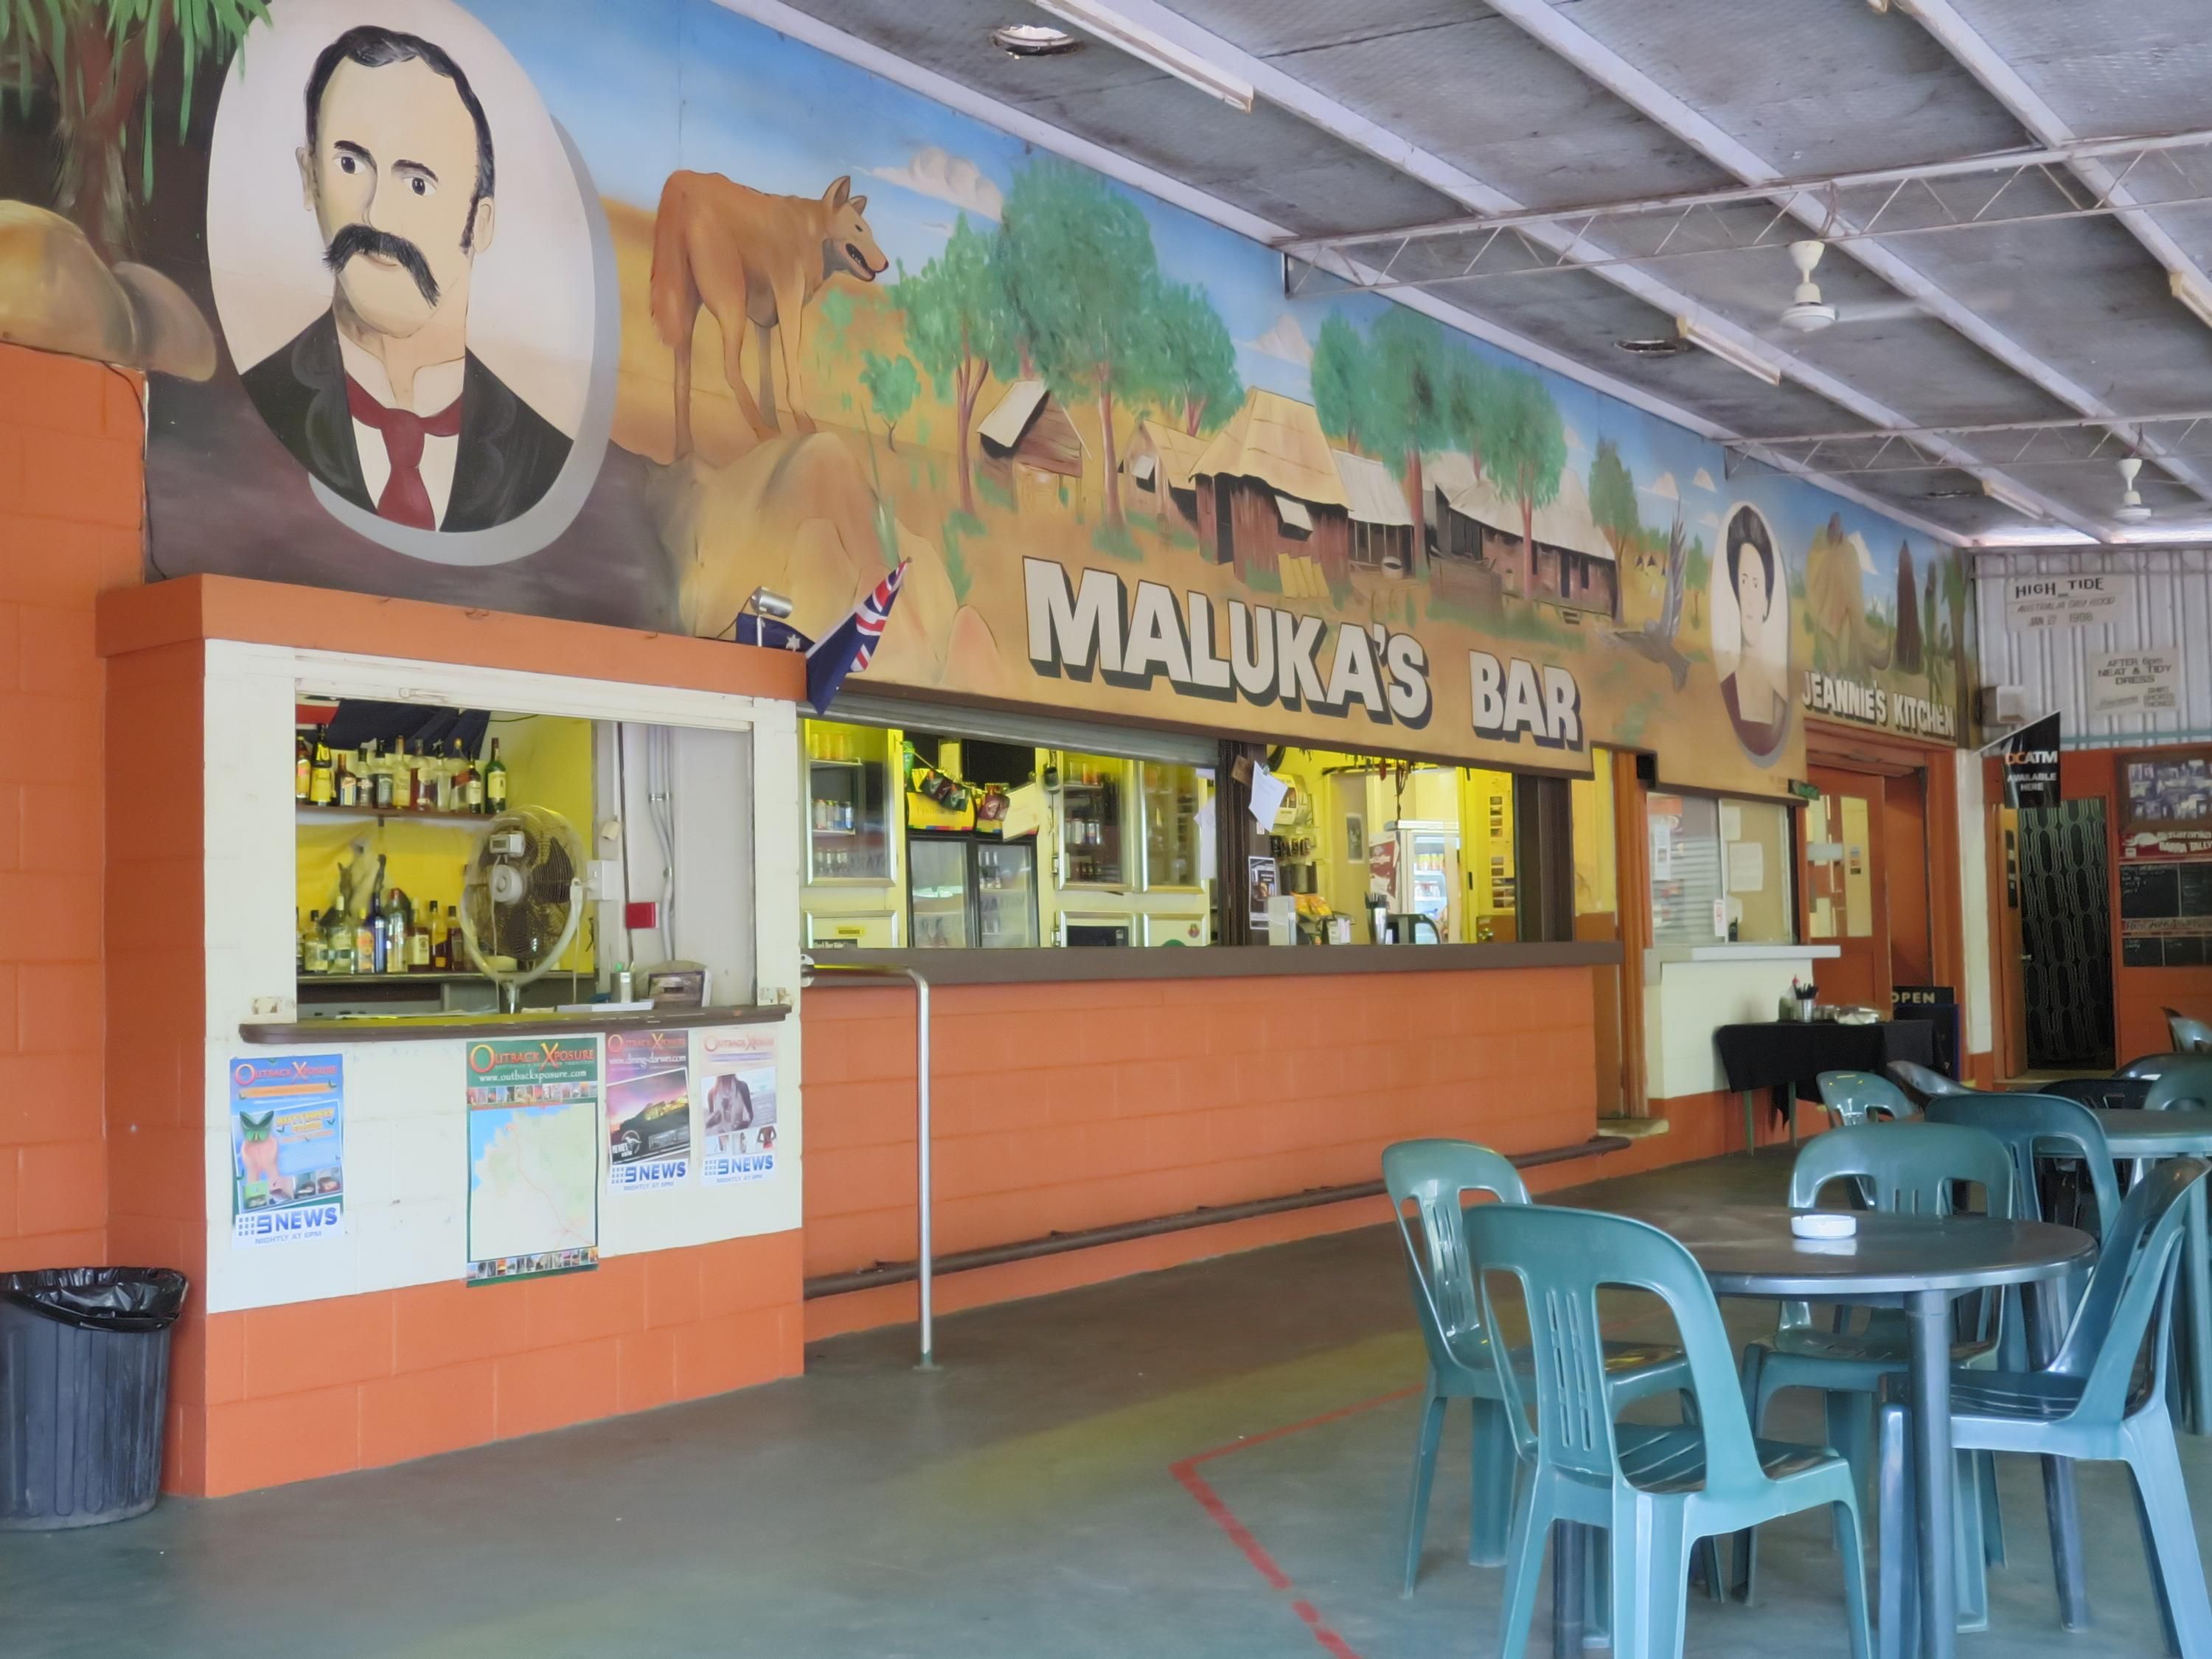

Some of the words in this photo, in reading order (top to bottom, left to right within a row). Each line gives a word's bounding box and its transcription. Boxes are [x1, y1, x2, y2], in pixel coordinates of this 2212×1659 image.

[2016, 582, 2056, 599] HIGH
[2067, 578, 2104, 591] TIDE
[1022, 556, 1430, 728] MALUKA'S
[1469, 649, 1582, 748] BAR
[2098, 668, 2126, 677] NEAT
[2147, 664, 2171, 673] TIDY
[2115, 675, 2155, 685] DRESS
[1802, 671, 1887, 726] JEANNIE'S
[1893, 692, 1955, 740] KITCHEN
[2007, 773, 2056, 782] AVAILABLE
[2020, 782, 2044, 791] HERE
[1891, 991, 1935, 1004] OPEN
[479, 1070, 587, 1084] www.outbackxposure.com
[639, 1161, 686, 1180] NEWS
[731, 1155, 773, 1173] NEWS
[275, 1207, 338, 1232] NEWS
[255, 1234, 289, 1245] NIGHTLY
